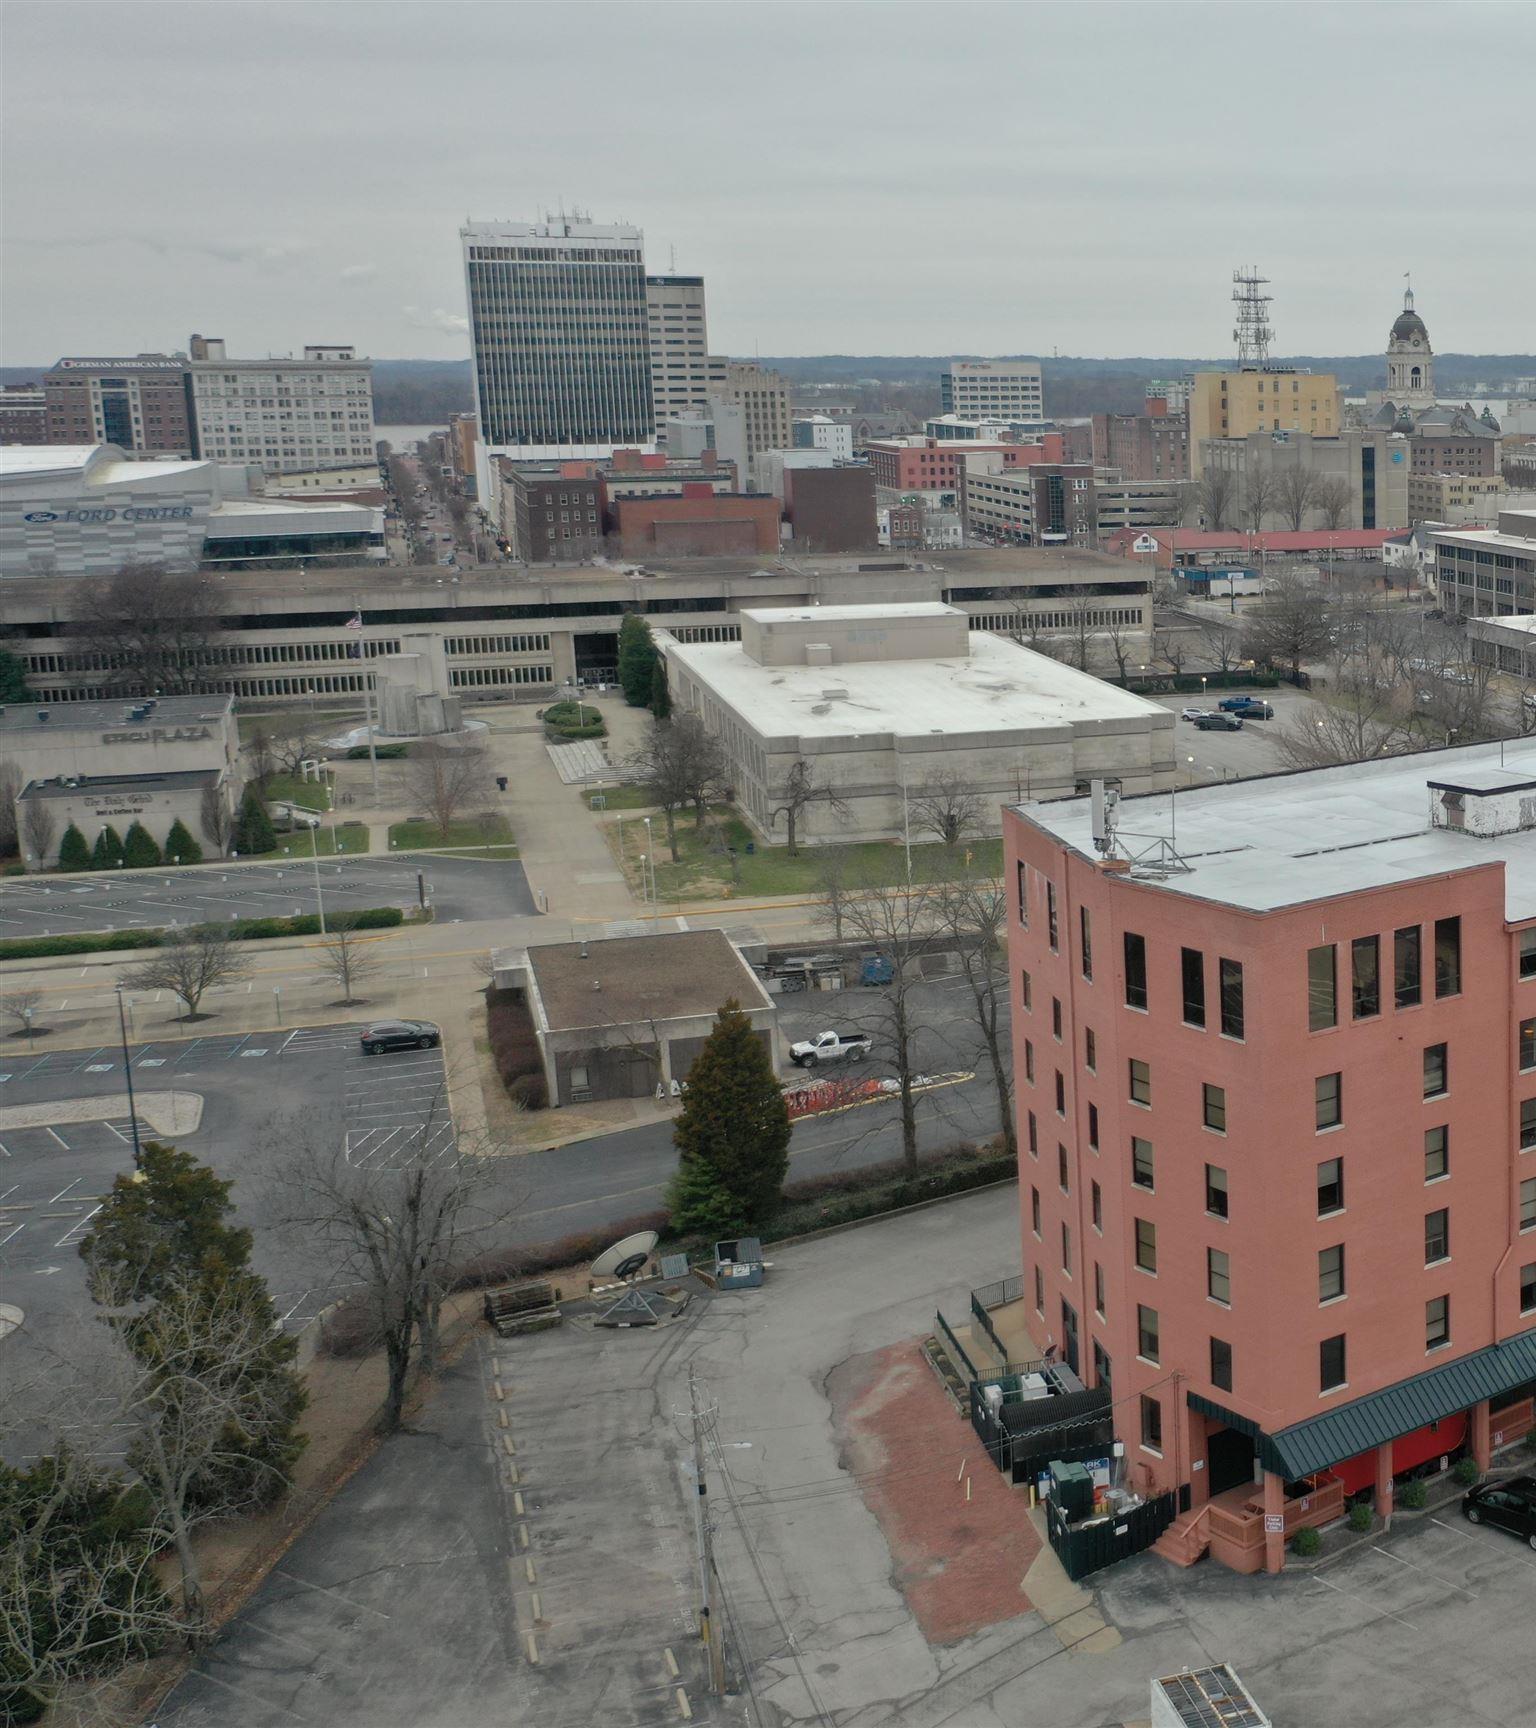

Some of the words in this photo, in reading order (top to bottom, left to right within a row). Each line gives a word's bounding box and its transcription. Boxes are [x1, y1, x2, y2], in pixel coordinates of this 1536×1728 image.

[65, 509, 117, 522] FORD
[122, 506, 193, 521] CENTER
[153, 725, 212, 743] PLAZA
